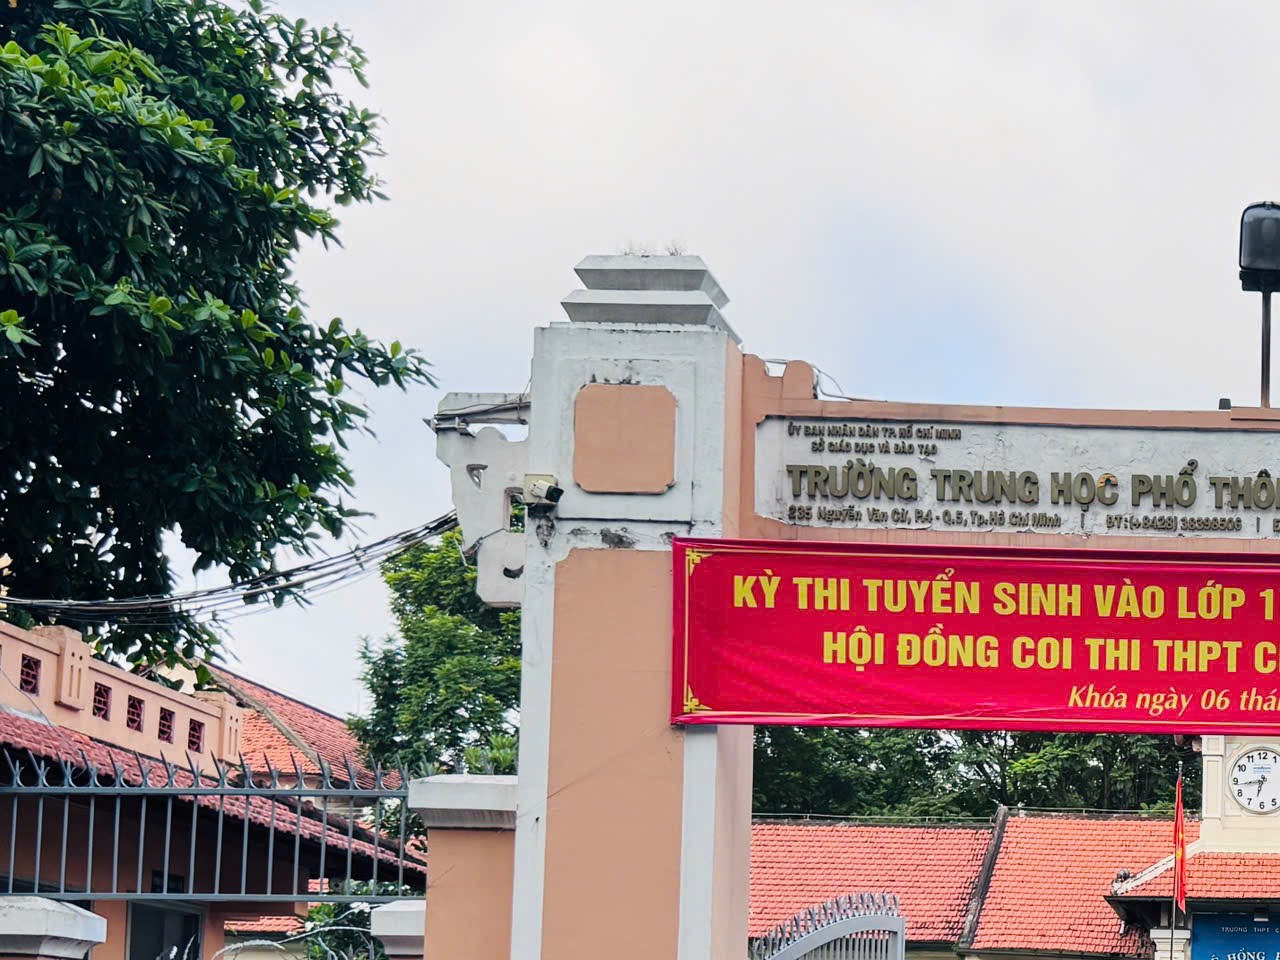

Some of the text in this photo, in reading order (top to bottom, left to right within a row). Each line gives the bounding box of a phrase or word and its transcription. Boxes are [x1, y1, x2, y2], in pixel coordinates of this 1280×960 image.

[786, 458, 917, 500] TRƯỜNG
[930, 469, 1039, 504] TRUNG
[1051, 472, 1119, 512] HỌC
[1131, 458, 1198, 507] PHỔ
[733, 568, 781, 610] KỲ
[793, 577, 849, 612] THI
[863, 567, 980, 615] TUYỂN
[993, 582, 1081, 617] SINH
[1093, 577, 1165, 619] VÀO
[1178, 581, 1246, 620] LỚP
[823, 625, 885, 671] HỘI
[897, 623, 998, 668] ĐỒNG
[1012, 636, 1072, 670] COI
[1086, 637, 1140, 671] THI
[1157, 638, 1242, 673] THPT
[1068, 685, 1128, 710] Khóa
[1135, 687, 1192, 716] ngày
[1200, 689, 1230, 711] 06
[1247, 755, 1254, 763] 11
[1257, 752, 1268, 760] 12
[1237, 764, 1246, 772] 10
[1233, 777, 1238, 785] 9
[1237, 789, 1242, 797] 8
[1271, 798, 1277, 806] 5
